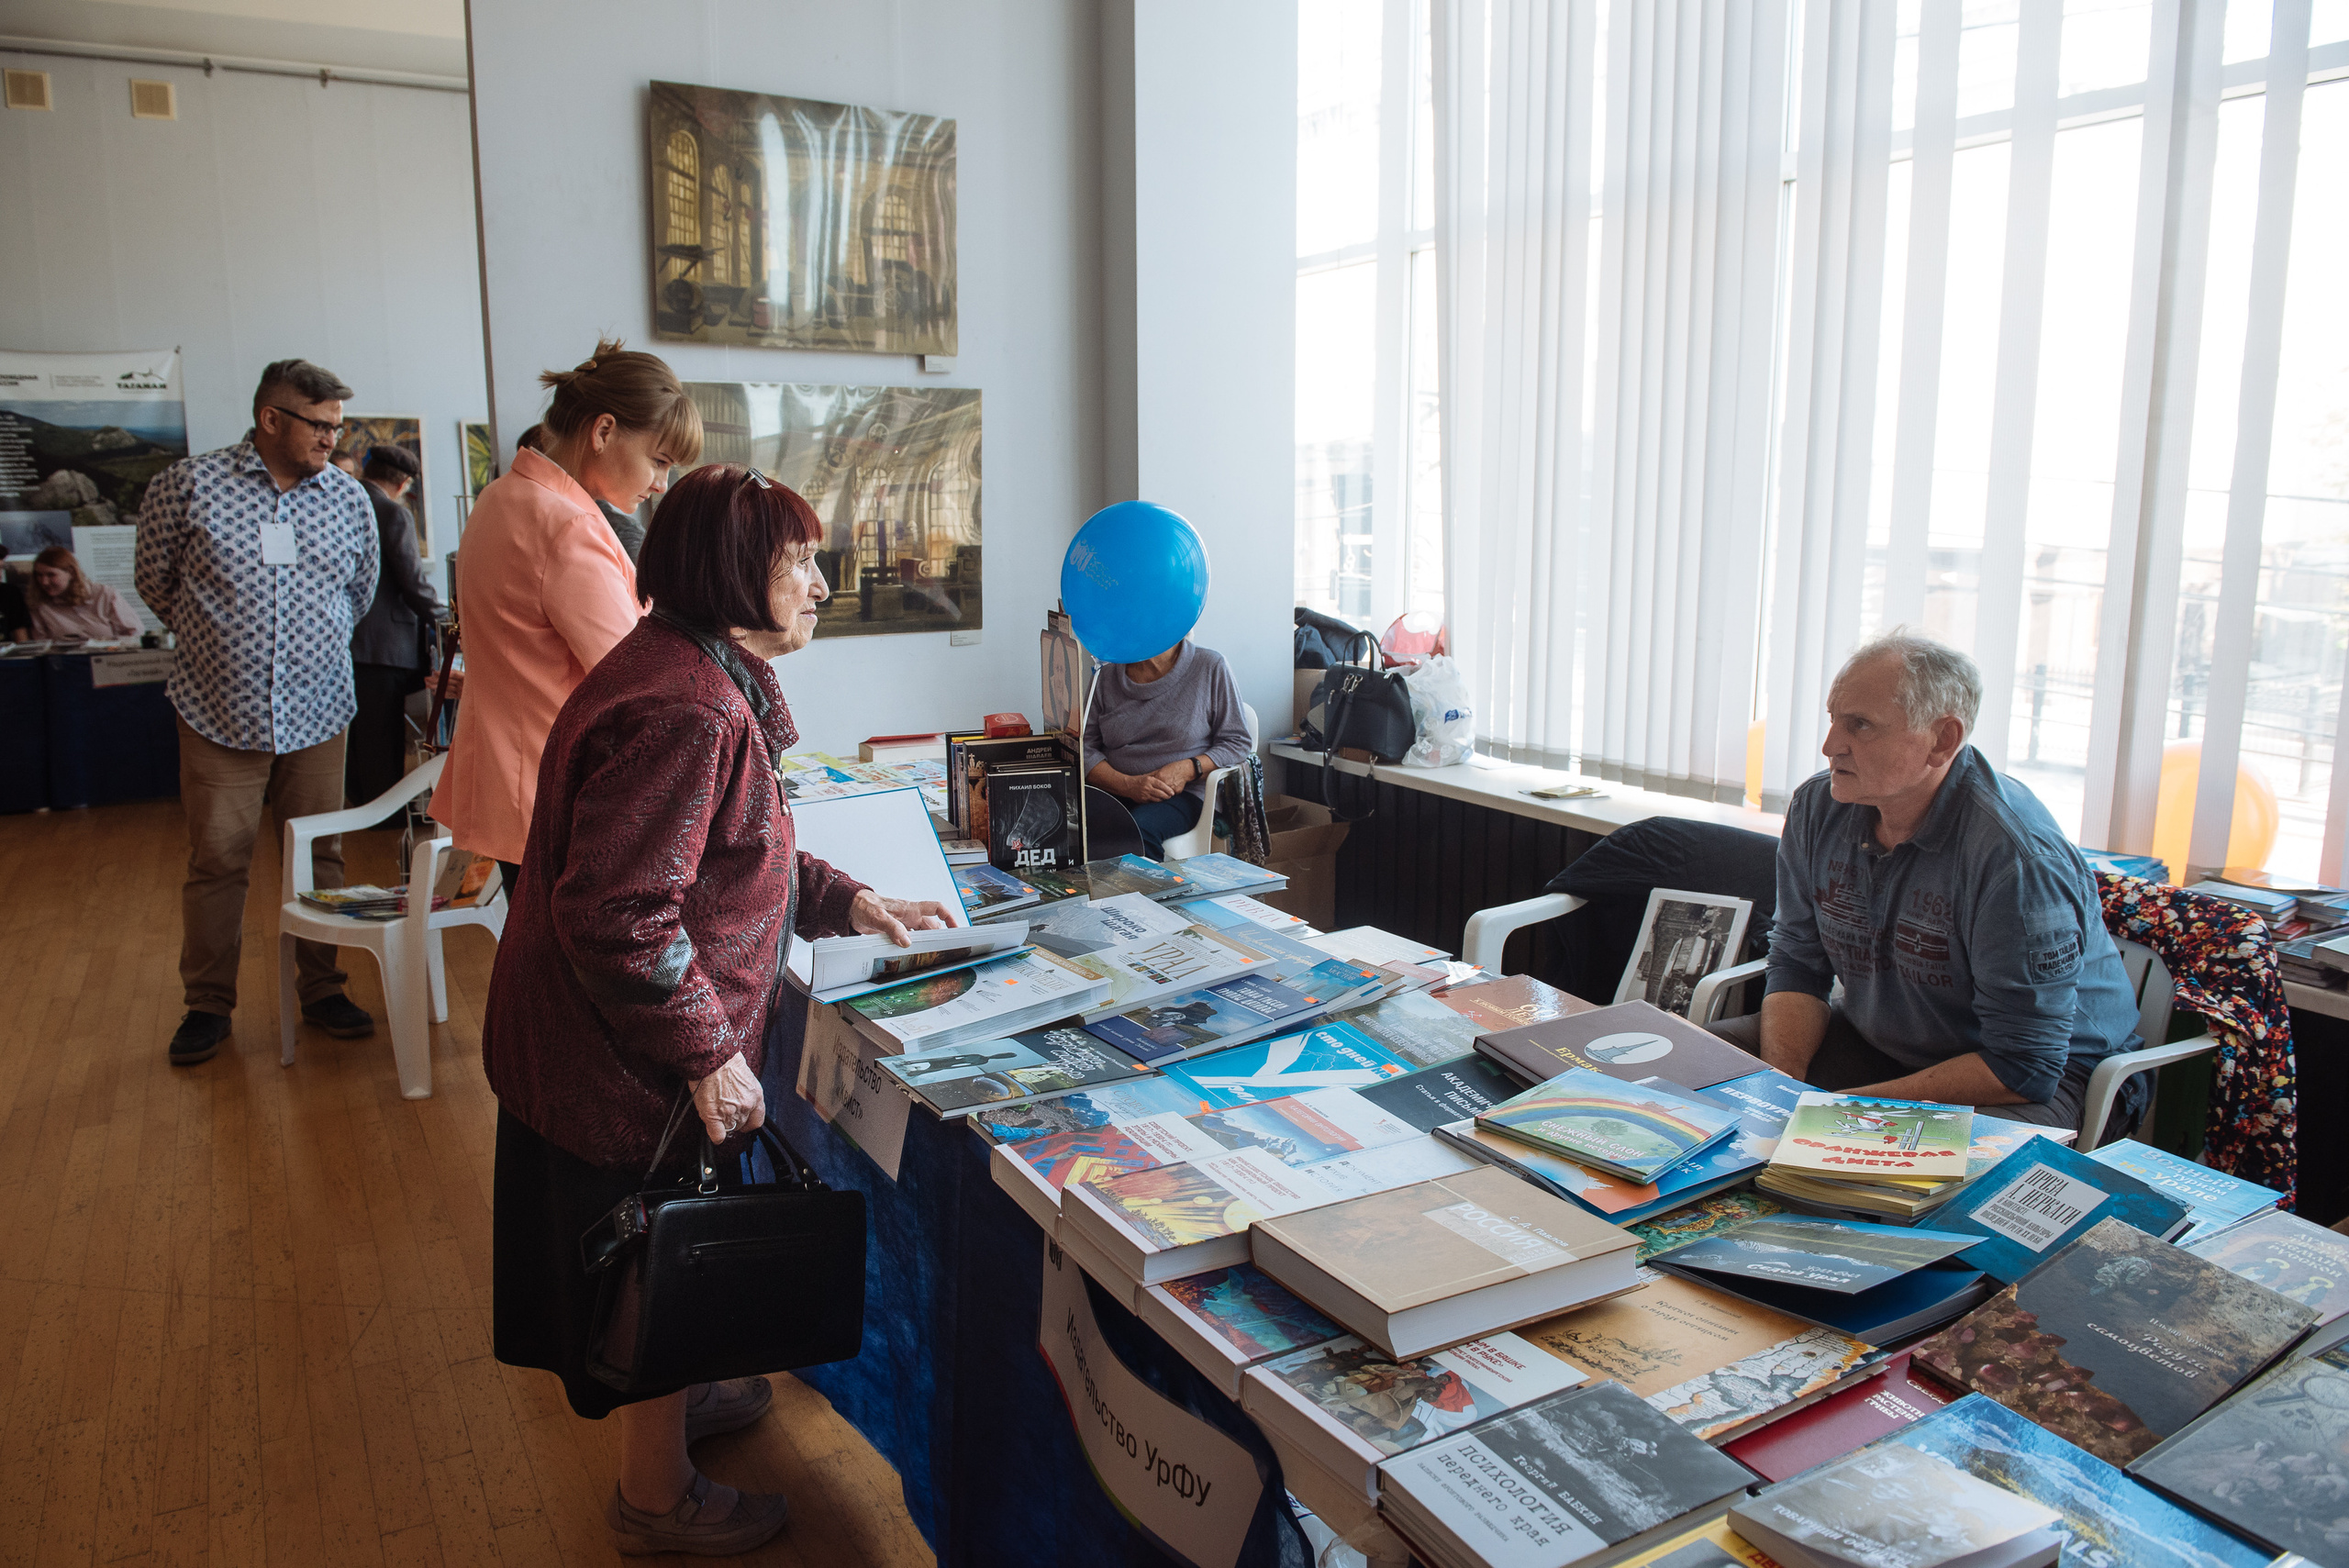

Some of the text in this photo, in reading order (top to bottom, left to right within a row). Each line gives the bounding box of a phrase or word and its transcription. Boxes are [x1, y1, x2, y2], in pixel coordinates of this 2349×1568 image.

[1027, 746, 1052, 754] АНДРЕЙ
[1015, 849, 1056, 867] ДЕД
[1101, 906, 1147, 933] Широко
[832, 1033, 882, 1095] Издательство
[1315, 1030, 1343, 1049] сто
[1336, 1044, 1377, 1068] дней
[1555, 1046, 1603, 1073] Ермак
[1415, 1084, 1435, 1104] Статьи
[1438, 1101, 1466, 1120] формате
[1443, 1091, 1483, 1118] ПИСЬМ
[1541, 1119, 1649, 1159] СНЕЖНЫЙ СЛОН
[1543, 1128, 1582, 1145] другие
[1584, 1141, 1631, 1161] истории
[1792, 1138, 1956, 1158] ОРАНЖЕВАЯ
[1821, 1156, 1915, 1168] ДИЕТА
[2024, 1169, 2069, 1197] ПРОЗА
[2119, 1162, 2218, 1203] на урале
[2173, 1173, 2228, 1196] туризм
[2006, 1184, 2025, 1200] А.
[2019, 1190, 2082, 1226] НЕРКАГИ
[1450, 1202, 1545, 1250] РОССИЯ
[1533, 1228, 1569, 1248] Павлов
[1477, 1351, 1504, 1367] РУКЕ»
[1495, 1351, 1526, 1370] БАШКЕ
[2087, 1322, 2199, 1378] самоцветов
[1066, 1307, 1211, 1507] Издательство УрФУ
[1864, 1397, 1899, 1419] ГРИБЫ
[1437, 1453, 1551, 1547] переднего края
[1458, 1445, 1574, 1536] ПСИХОЛОГИЯ
[1513, 1454, 1604, 1526] Георгий БАБКИН
[1772, 1504, 1844, 1540] ТОВАРИЩИ
